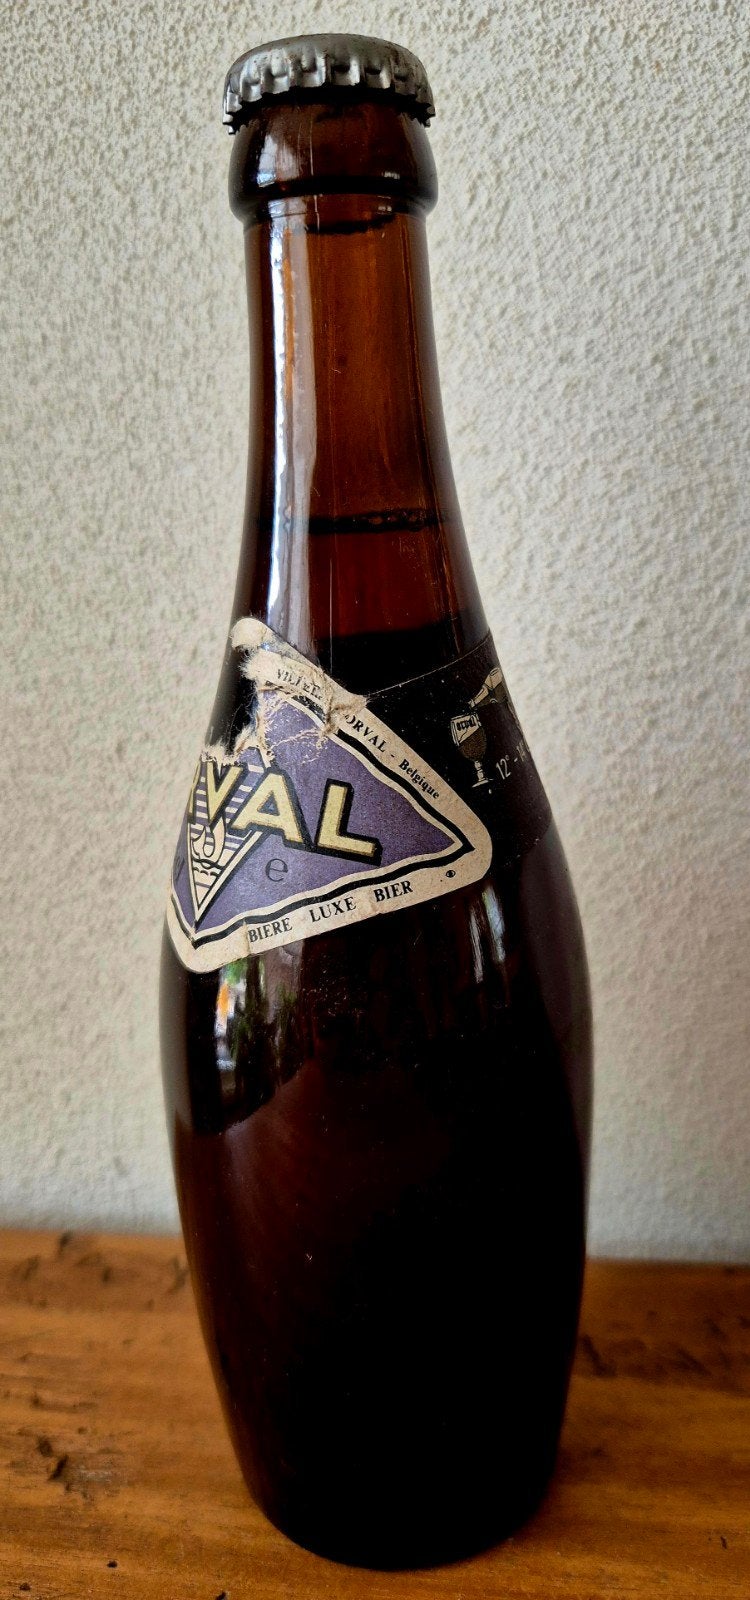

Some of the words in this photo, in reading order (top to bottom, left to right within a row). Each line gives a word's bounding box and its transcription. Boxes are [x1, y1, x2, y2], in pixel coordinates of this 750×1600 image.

[398, 758, 440, 800] Belgique
[265, 857, 289, 882] e
[249, 917, 293, 943] BIERE
[308, 895, 357, 923] LUXE
[373, 879, 414, 903] BIER
